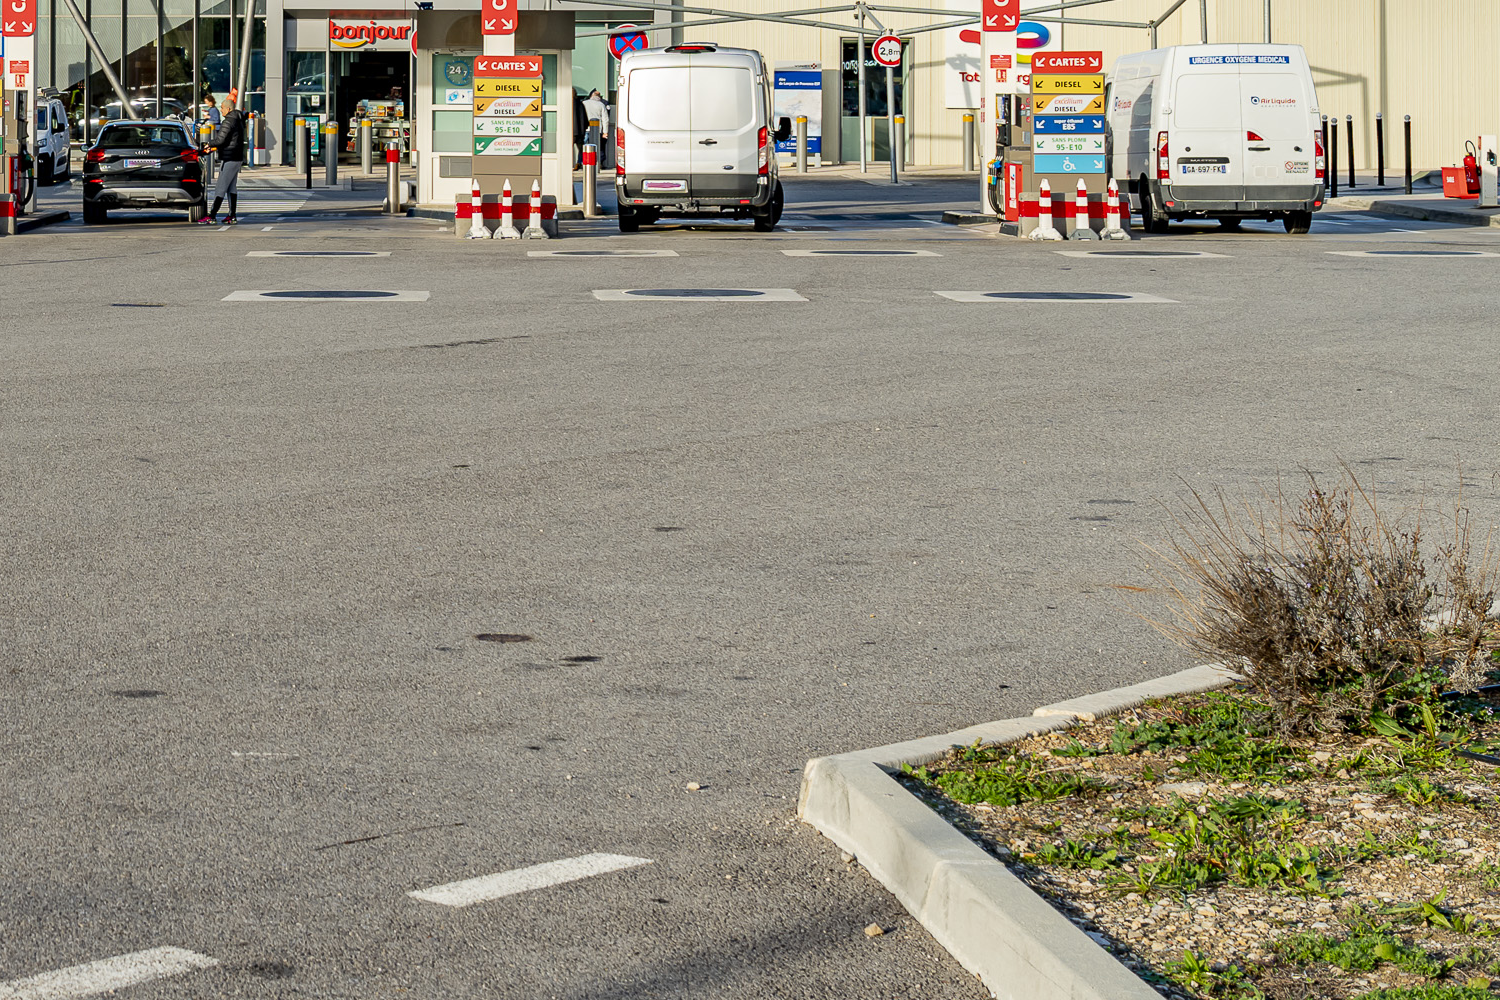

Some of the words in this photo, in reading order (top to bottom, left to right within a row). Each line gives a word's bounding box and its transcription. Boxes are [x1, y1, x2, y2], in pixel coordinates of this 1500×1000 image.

[329, 20, 411, 44] bonjour
[491, 62, 526, 70] CARTES
[1049, 58, 1085, 66] CARTES
